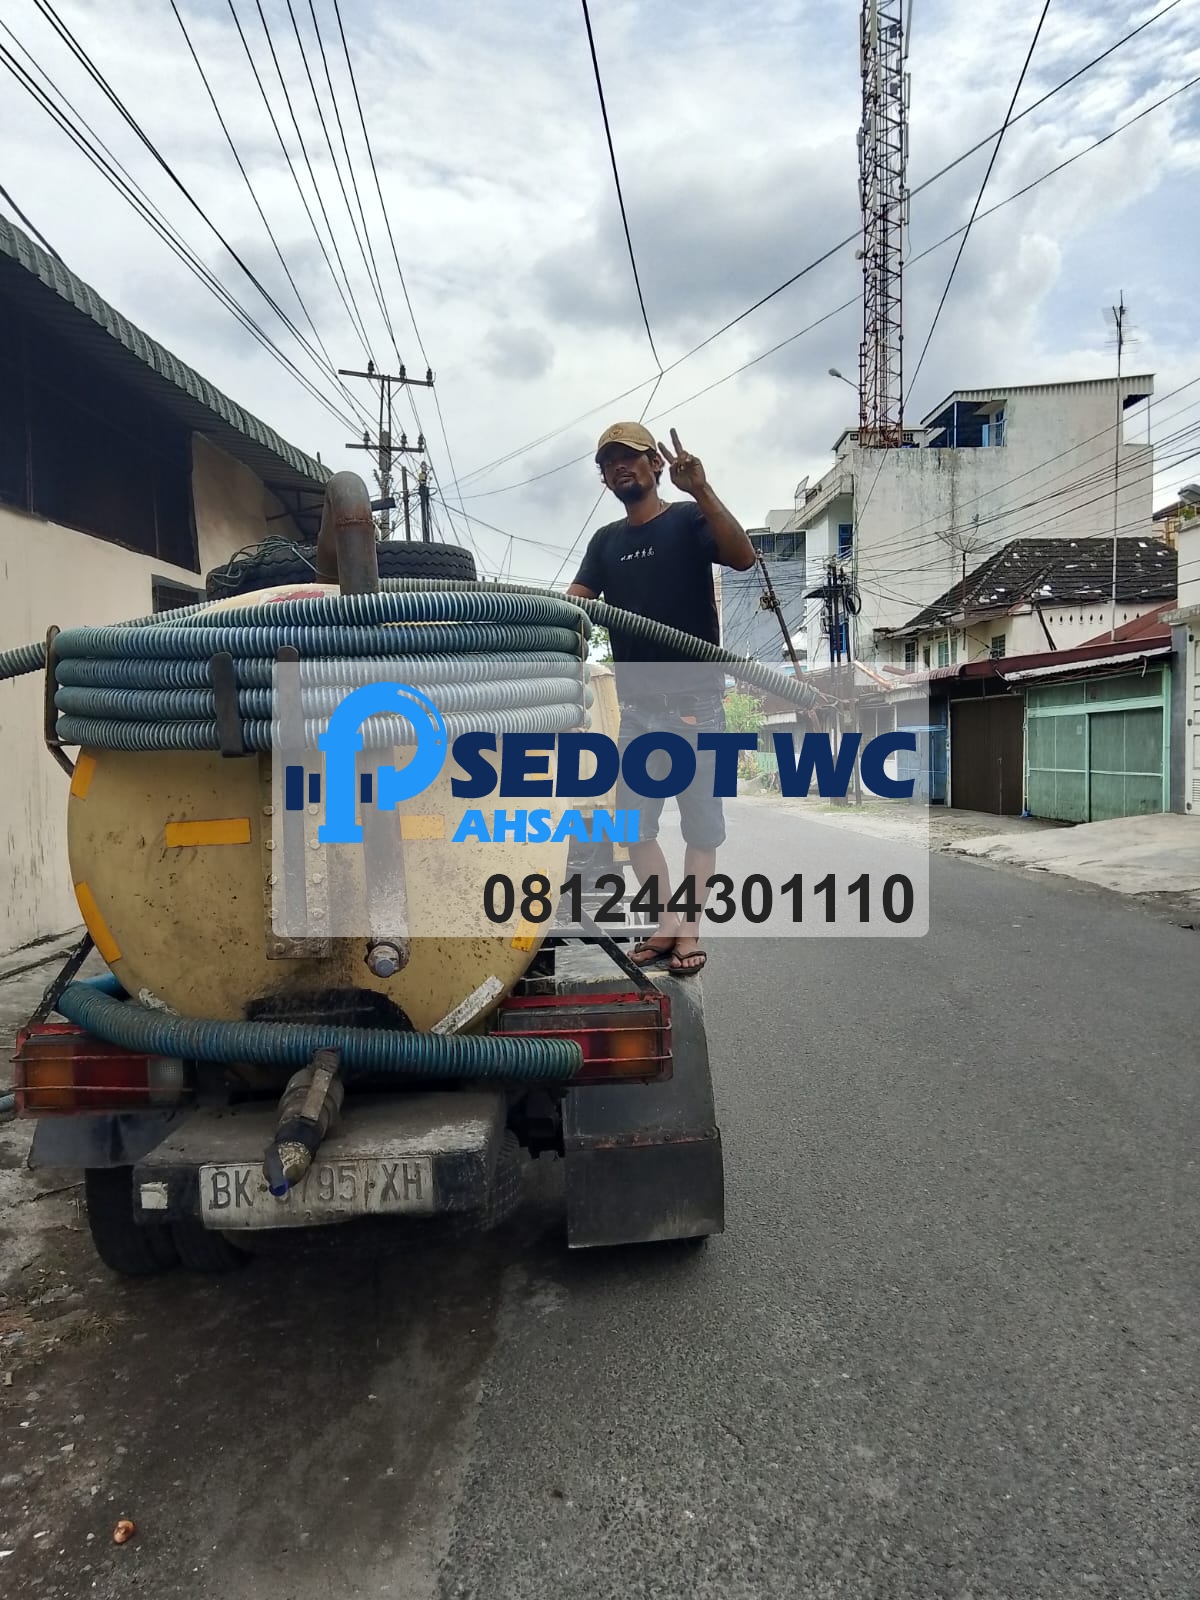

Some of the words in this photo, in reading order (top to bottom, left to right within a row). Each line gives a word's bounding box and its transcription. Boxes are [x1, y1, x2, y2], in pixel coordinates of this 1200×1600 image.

[208, 1170, 255, 1210] BK
[274, 1163, 356, 1204] 795
[379, 1161, 424, 1201] XH
